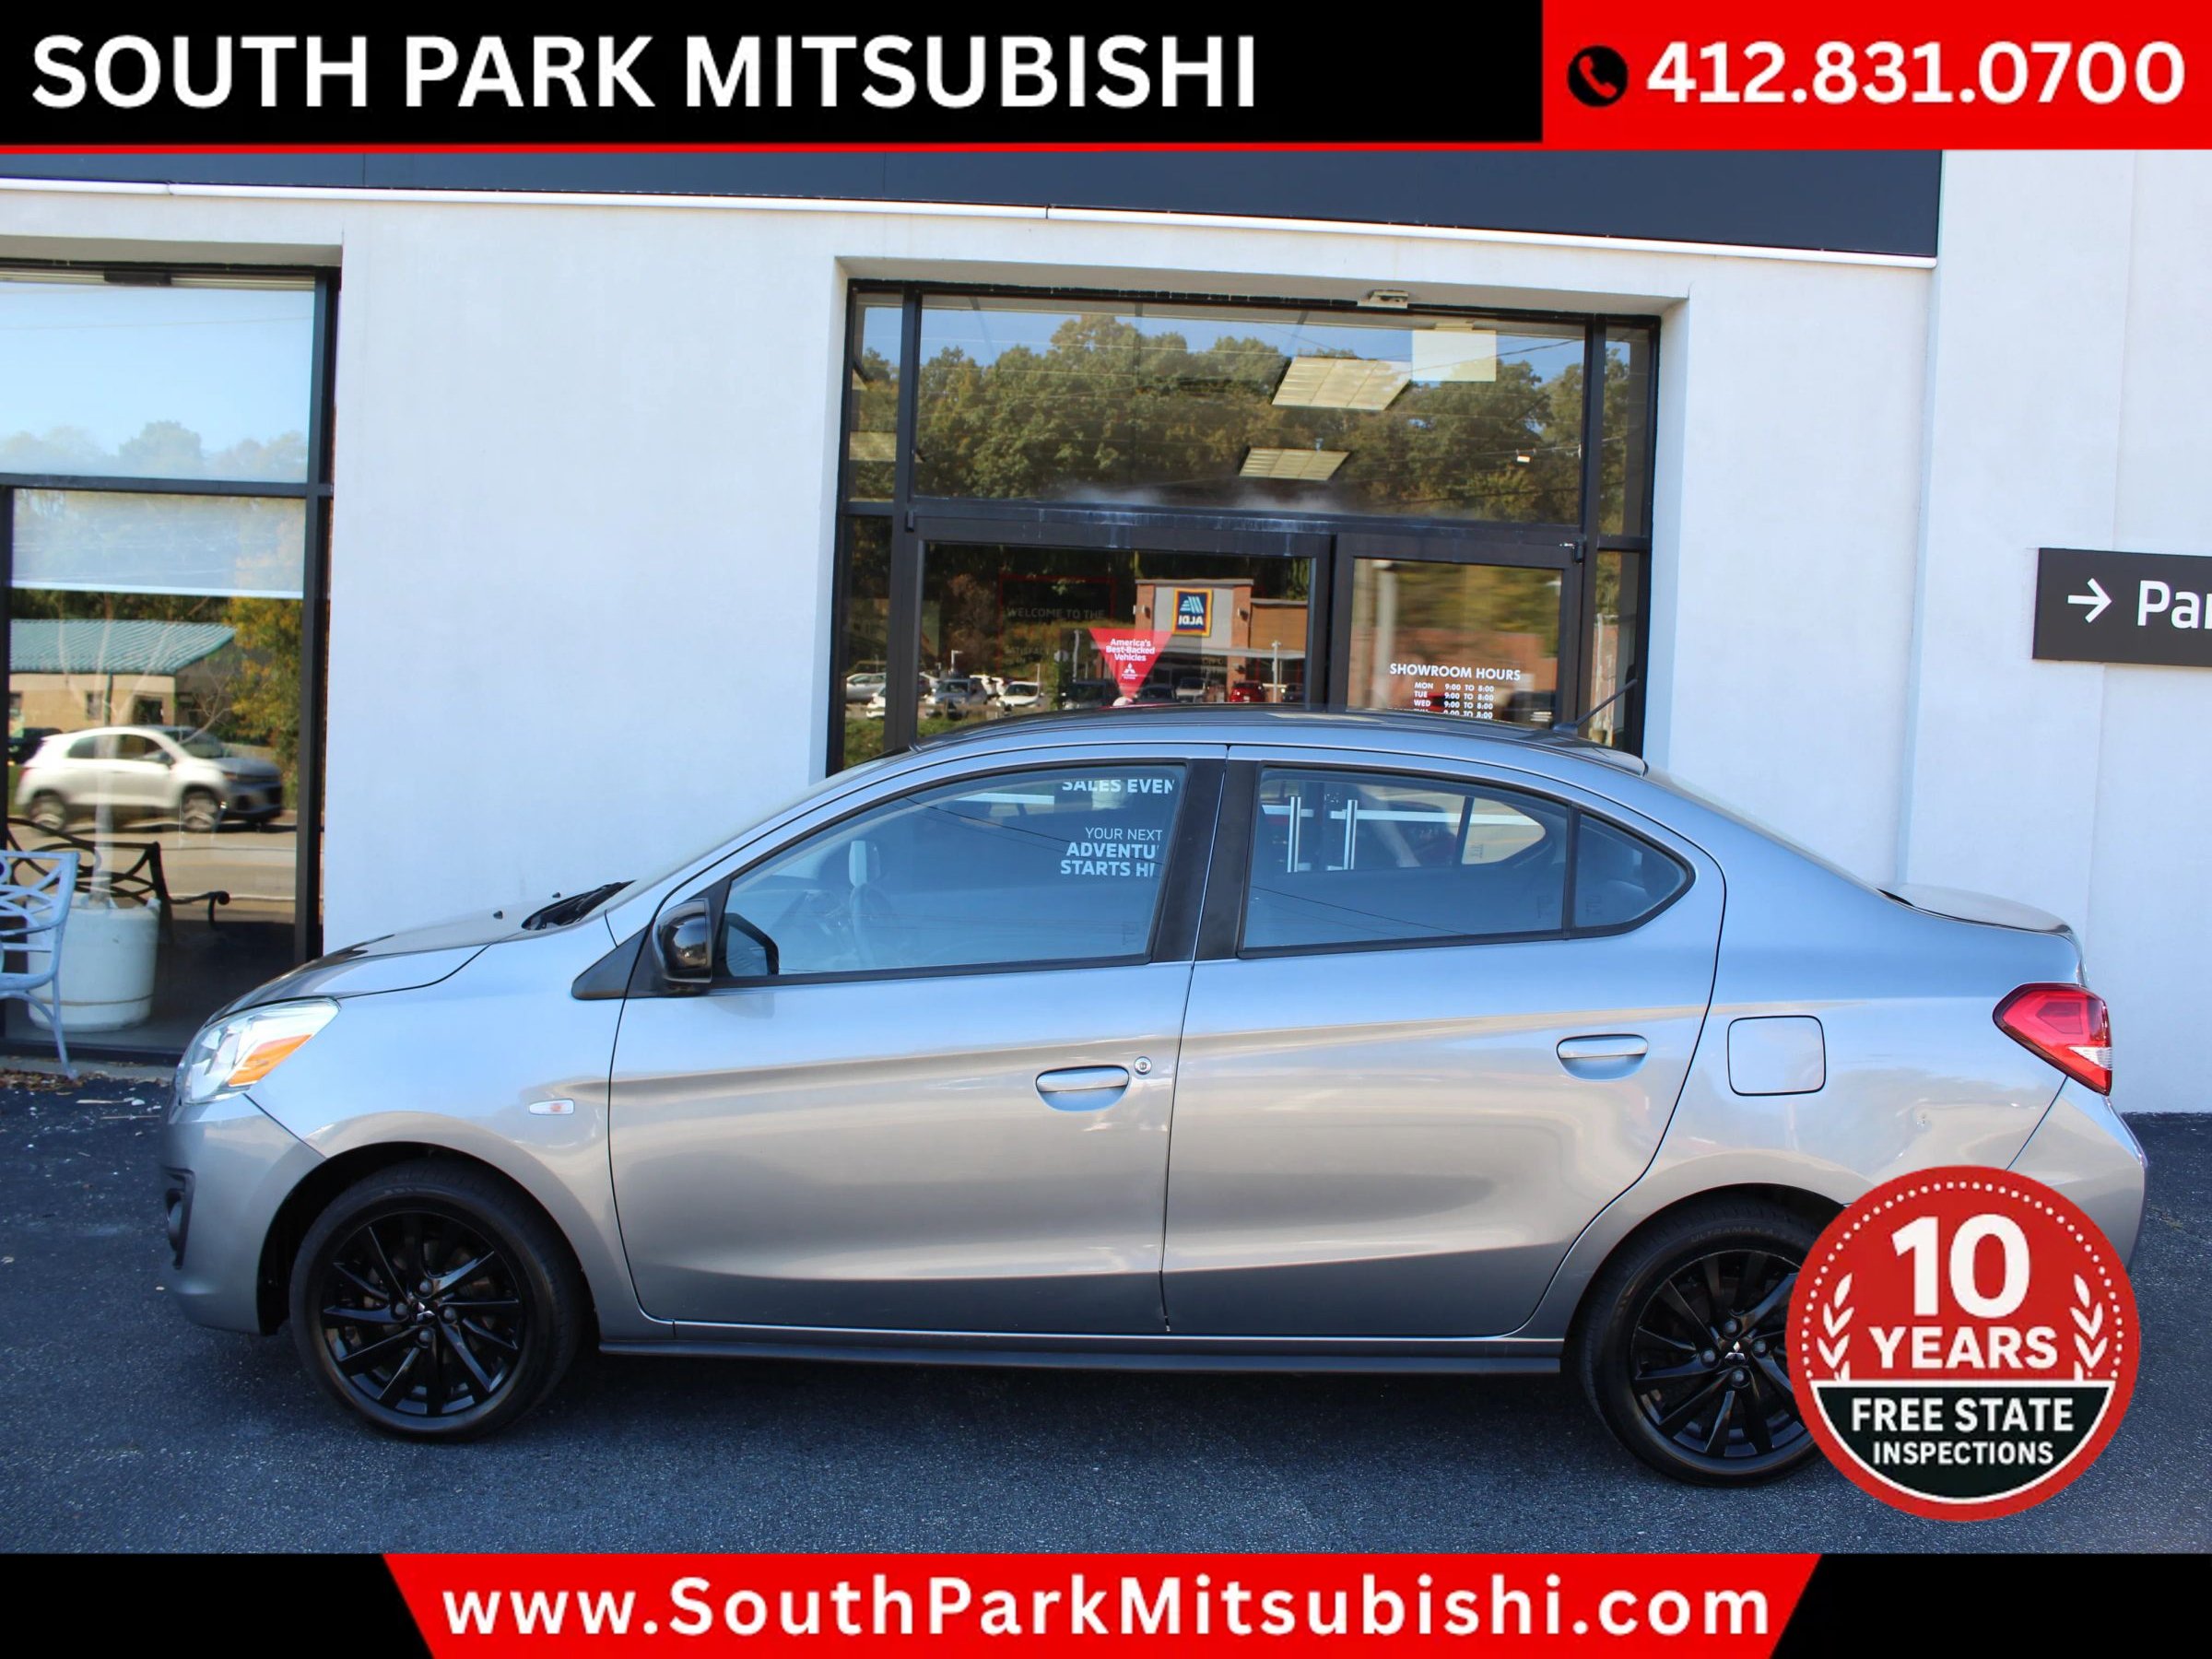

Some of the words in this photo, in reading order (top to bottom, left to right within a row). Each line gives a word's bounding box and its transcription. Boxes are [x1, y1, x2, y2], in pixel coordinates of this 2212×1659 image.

[1007, 607, 1063, 618] WELCOME
[1066, 609, 1079, 618] TO
[1084, 609, 1105, 618] THE
[1110, 638, 1151, 647] America's
[1106, 645, 1155, 654] Best-Backed
[1114, 653, 1147, 662] Vehicles
[1389, 663, 1472, 678] SHOWROOM
[1476, 668, 1521, 681] HOURS
[1413, 699, 1431, 707] WED
[1062, 779, 1122, 793] SALES
[1085, 827, 1123, 840] YOUR
[1127, 829, 1162, 841] NEXT
[1066, 841, 1159, 859] ADVENTU
[1060, 859, 1131, 877] STARTS
